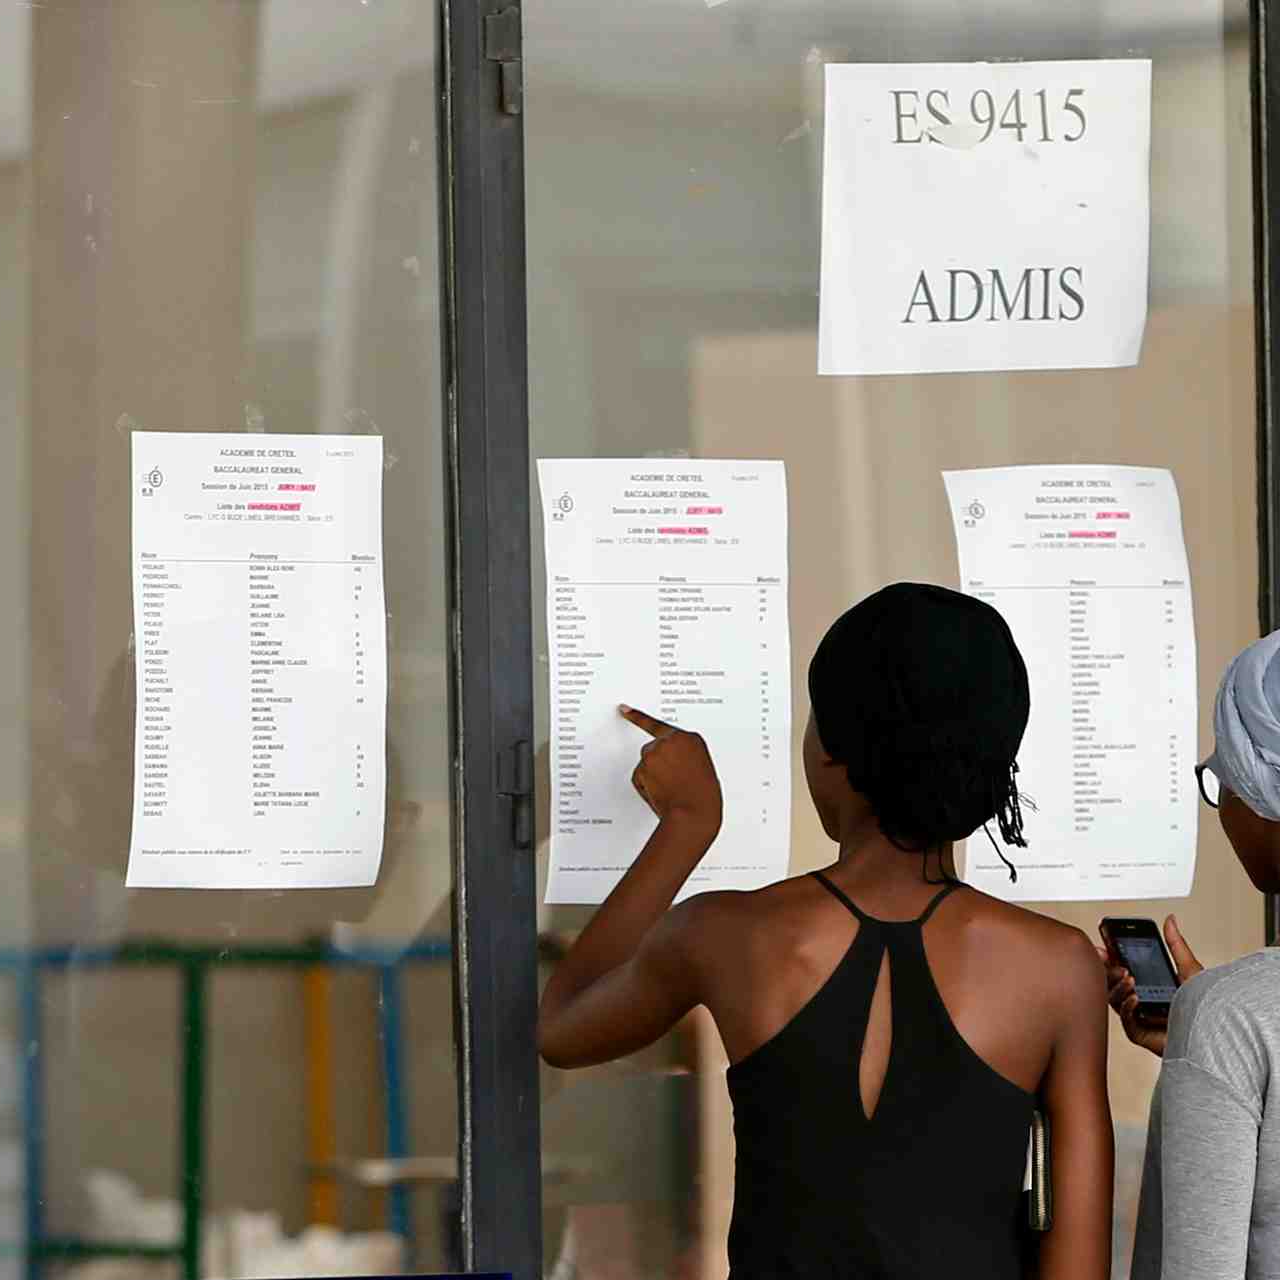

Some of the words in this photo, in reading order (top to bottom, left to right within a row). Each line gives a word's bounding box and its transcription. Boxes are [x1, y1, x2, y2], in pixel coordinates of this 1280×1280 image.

[889, 89, 952, 144] ES
[970, 89, 1085, 142] 9415
[902, 268, 1084, 322] ADMIS
[630, 474, 664, 482] ACADEMIE
